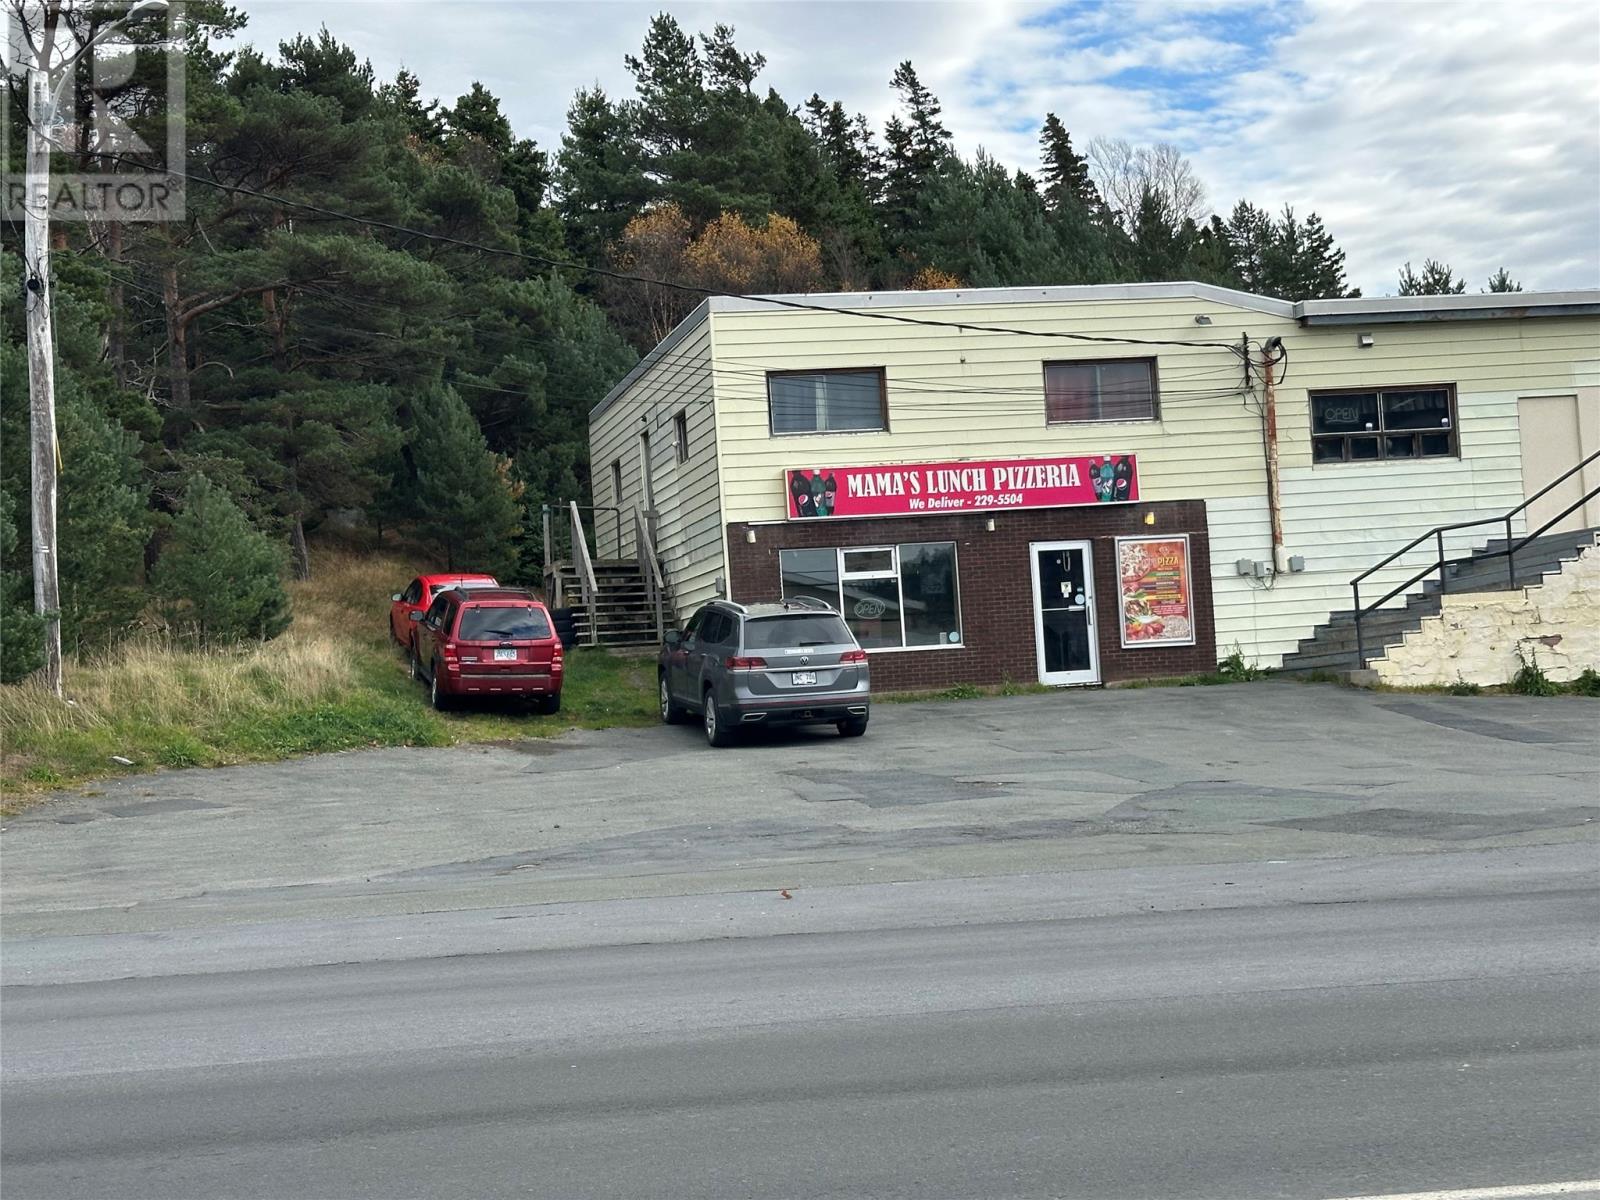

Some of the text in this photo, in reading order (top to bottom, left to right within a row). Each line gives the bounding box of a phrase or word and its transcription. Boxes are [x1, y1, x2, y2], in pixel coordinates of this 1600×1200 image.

[1324, 407, 1359, 420] OPEN
[847, 463, 1081, 498] MAMA'S LUNCH PIZZERIA
[909, 498, 925, 509] We
[927, 496, 965, 509] Deliver
[974, 493, 1023, 506] 229-5504
[1157, 556, 1179, 567] PIZZA
[856, 599, 884, 615] OPEN
